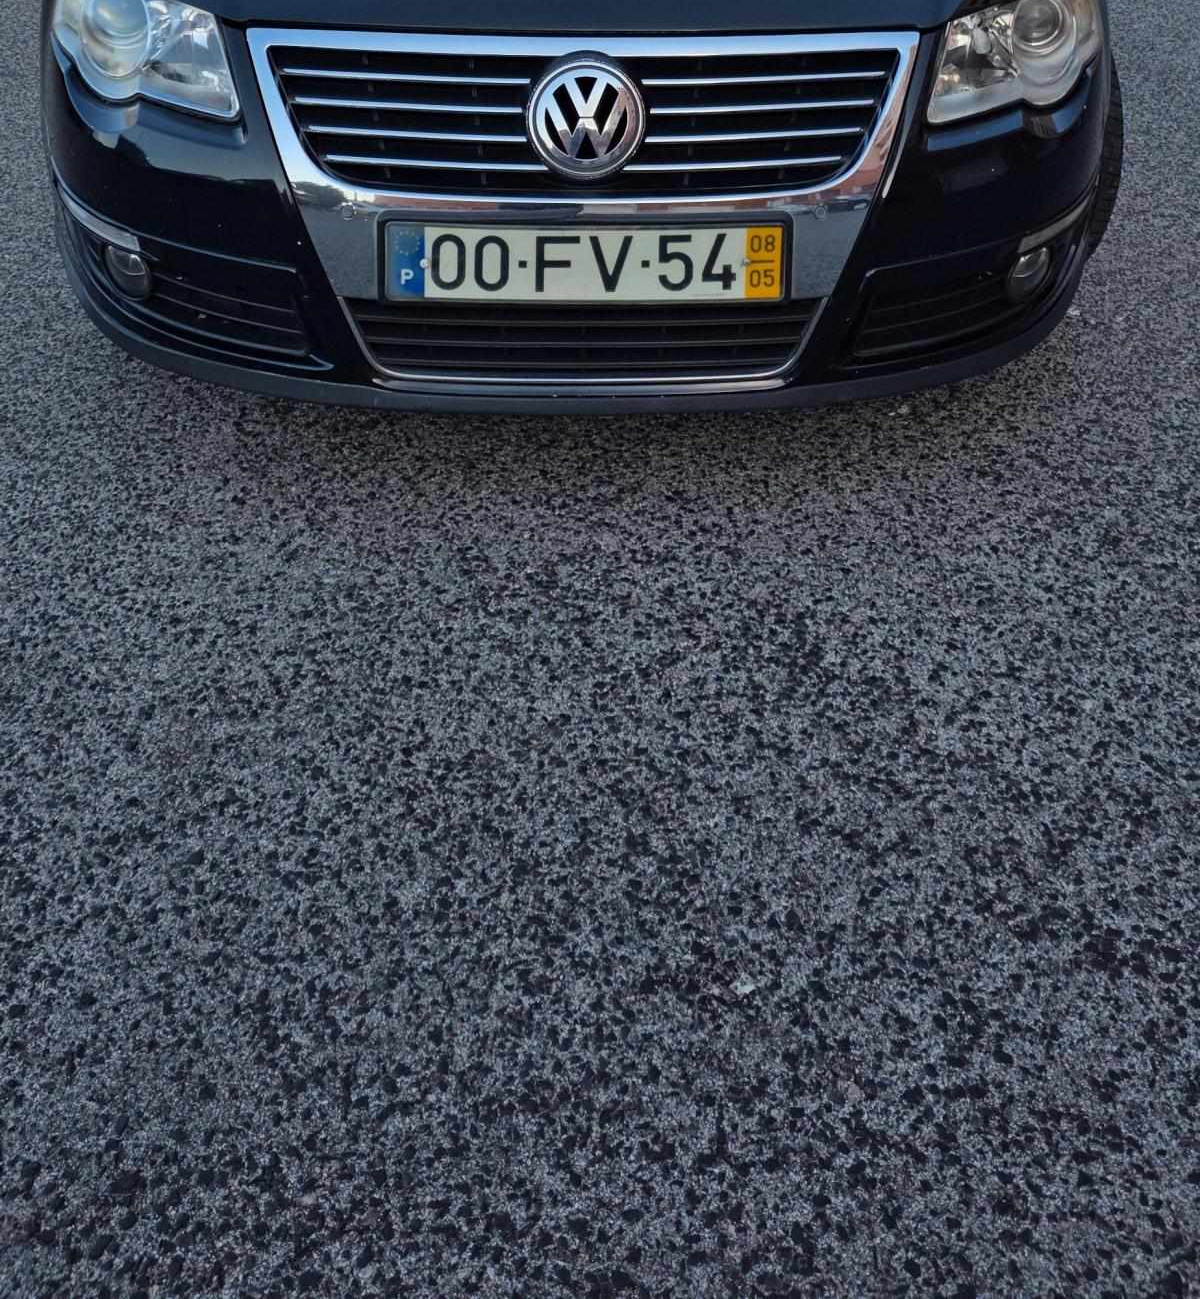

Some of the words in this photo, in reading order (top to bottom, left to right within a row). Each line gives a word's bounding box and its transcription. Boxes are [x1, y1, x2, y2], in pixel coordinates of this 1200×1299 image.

[536, 69, 636, 166] VW
[750, 234, 775, 253] 08
[400, 268, 414, 285] P
[749, 269, 775, 288] 05
